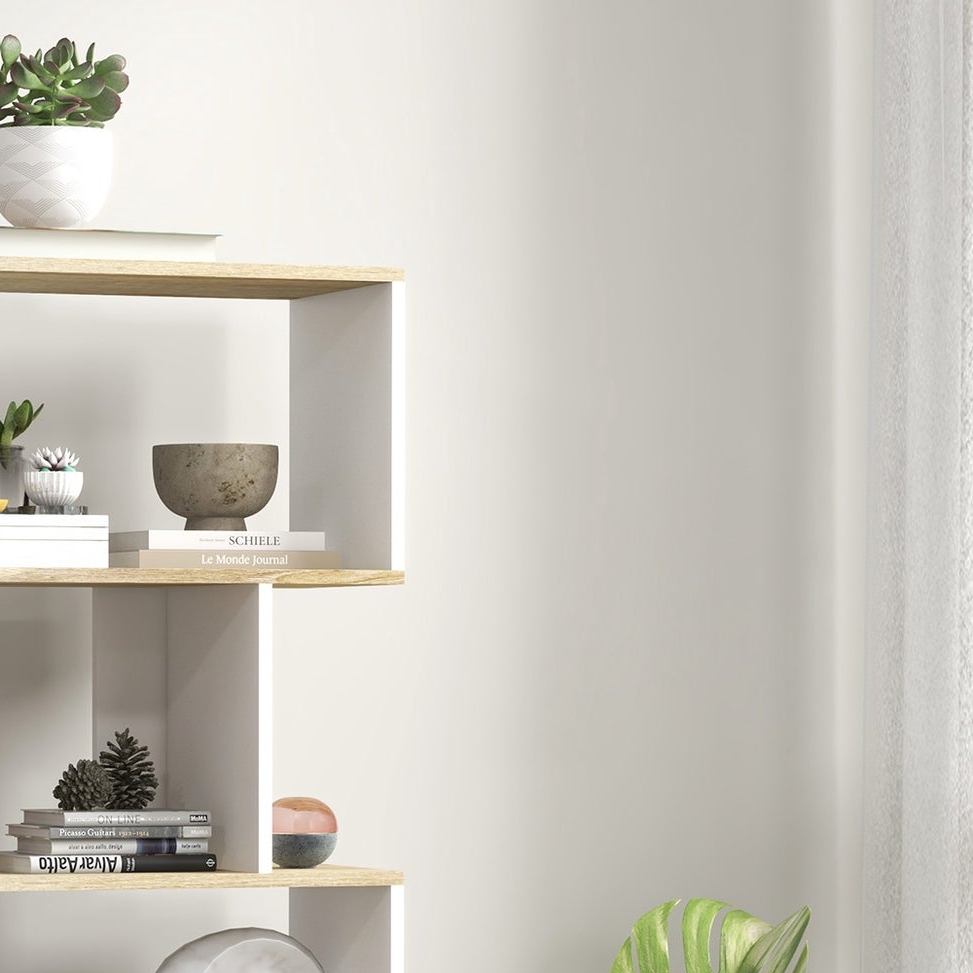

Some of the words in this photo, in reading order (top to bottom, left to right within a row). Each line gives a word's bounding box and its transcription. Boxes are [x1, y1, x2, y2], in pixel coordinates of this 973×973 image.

[229, 536, 281, 546] SCHIELE
[201, 555, 213, 565] Le
[216, 554, 250, 565] Monde
[252, 555, 288, 567] Journal
[97, 815, 113, 824] ON
[117, 815, 141, 824] LINE
[59, 828, 86, 837] Picasso
[87, 827, 116, 837] Guitars
